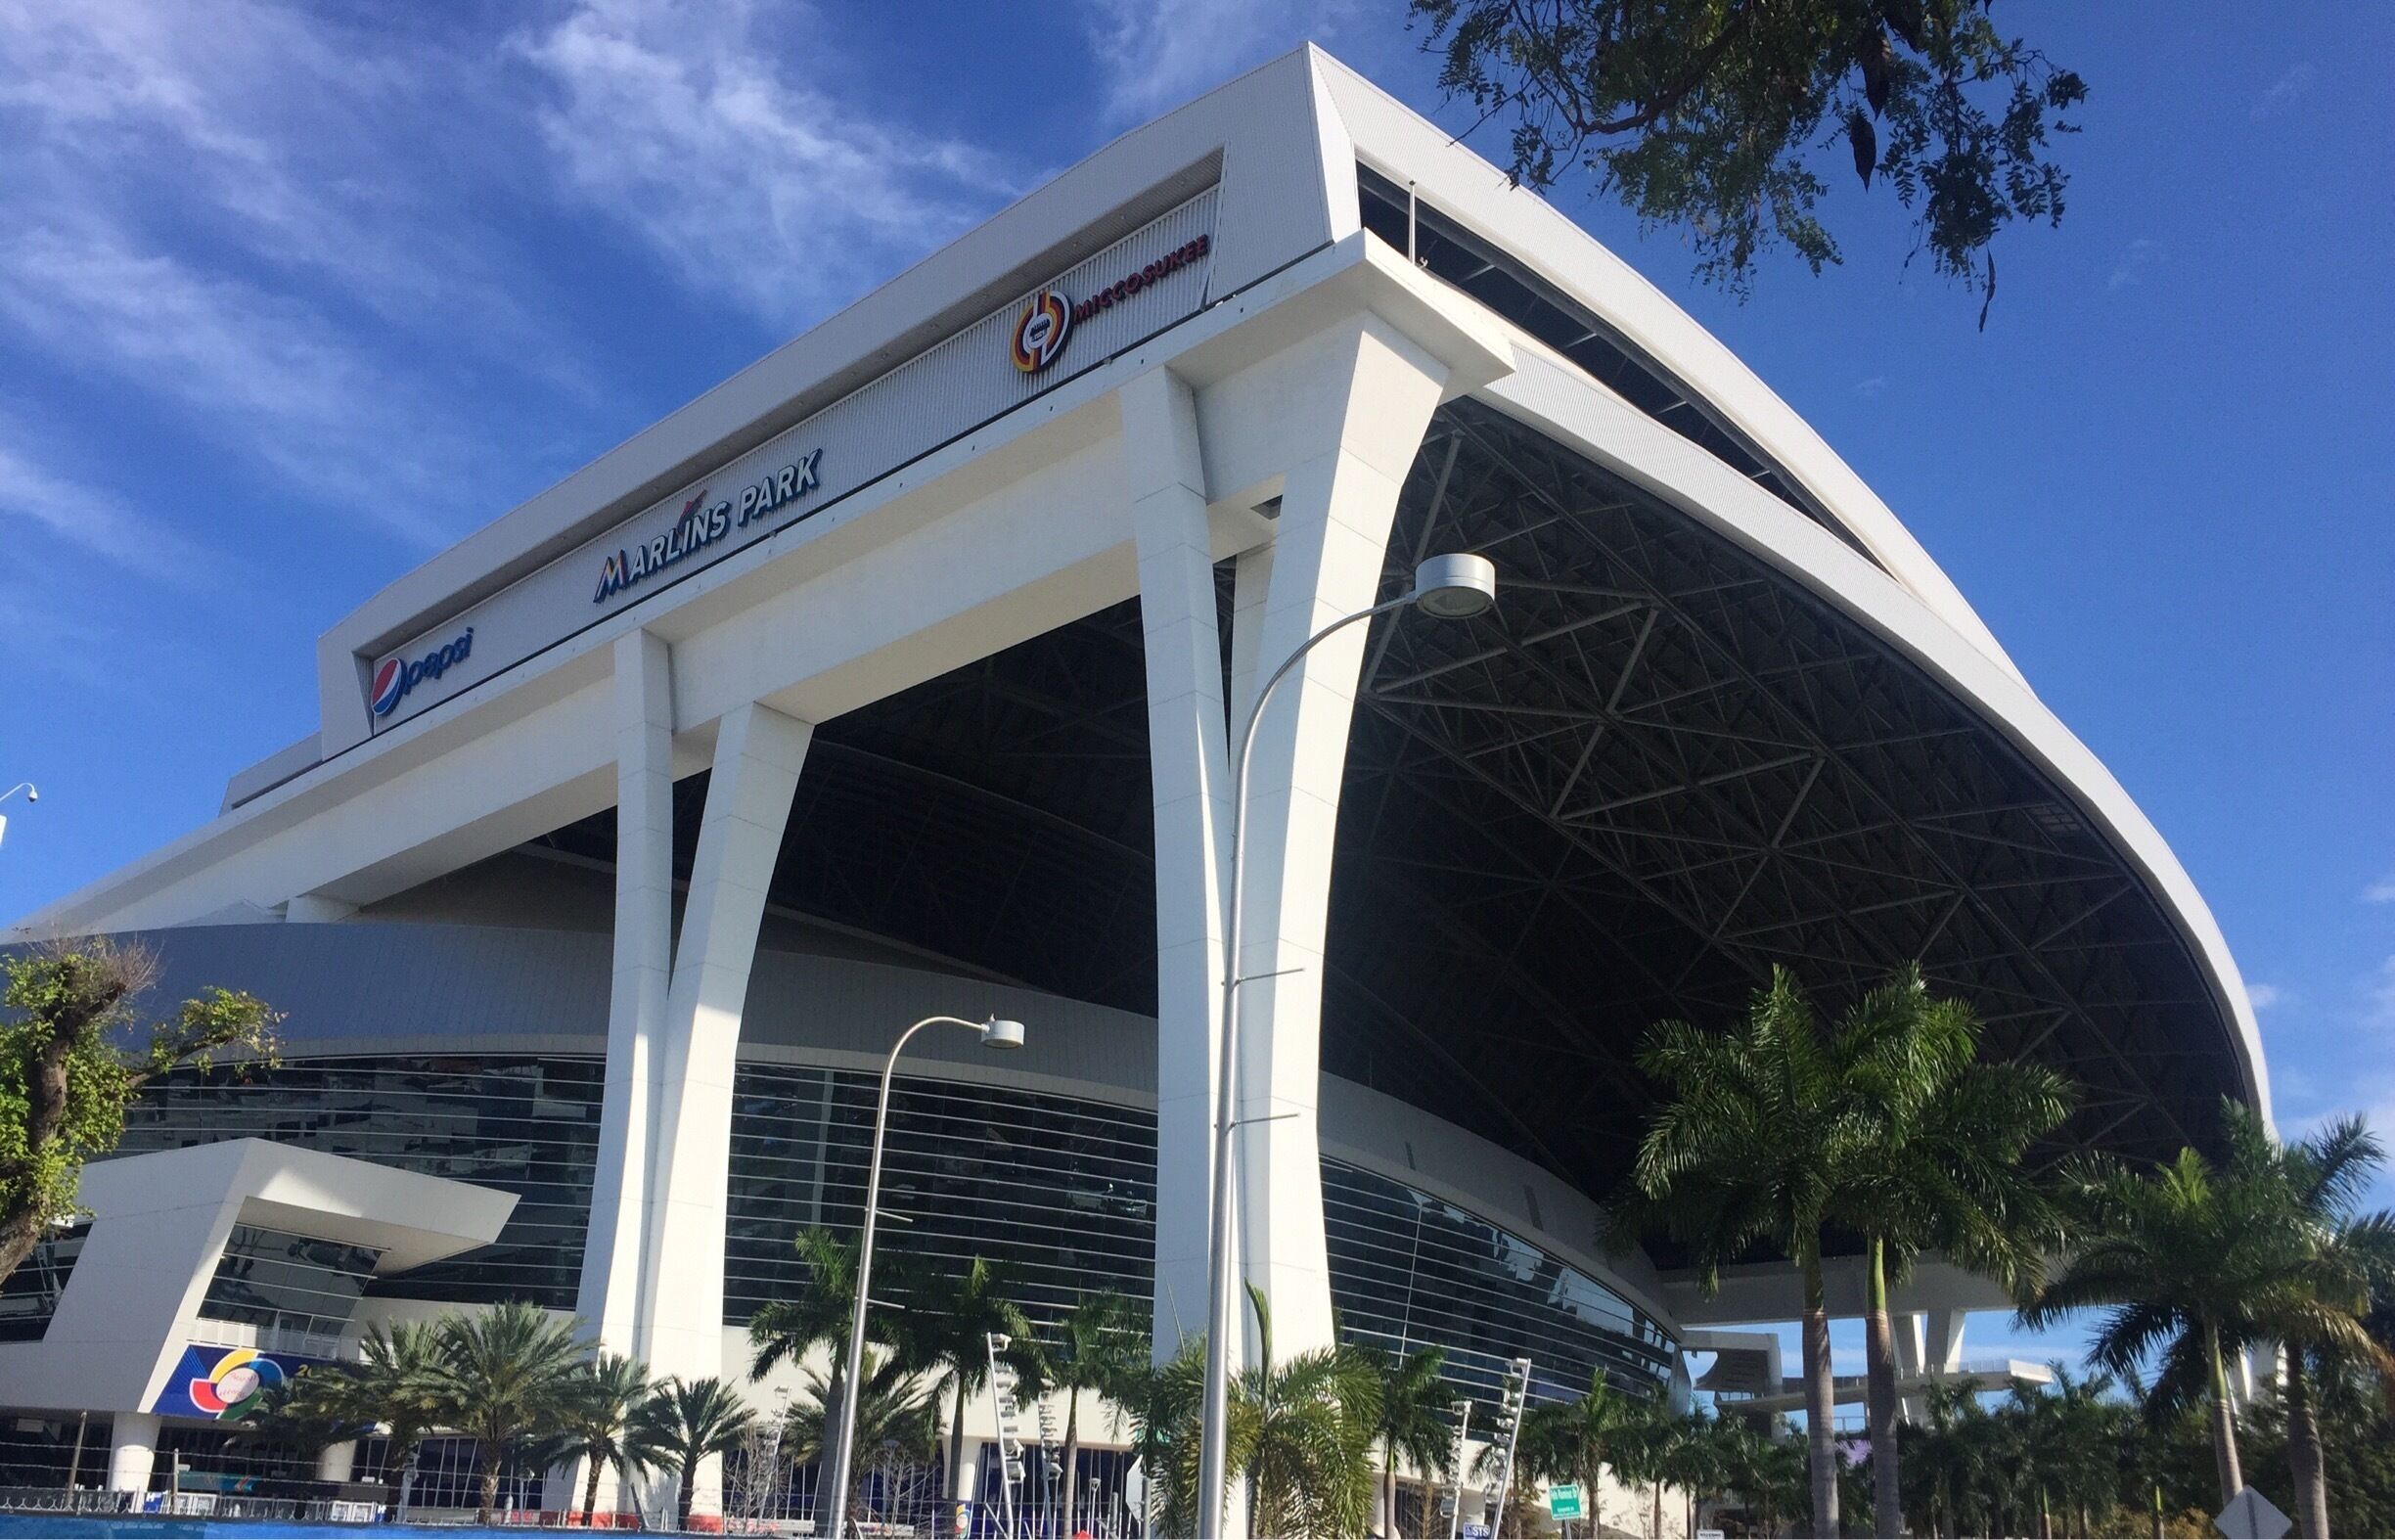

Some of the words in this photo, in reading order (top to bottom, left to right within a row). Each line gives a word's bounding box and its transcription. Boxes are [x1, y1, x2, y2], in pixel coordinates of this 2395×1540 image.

[1074, 234, 1209, 325] MICCOSUKEE
[593, 500, 732, 604] MARLINS
[738, 448, 823, 527] PARK
[402, 626, 474, 696] pepsi
